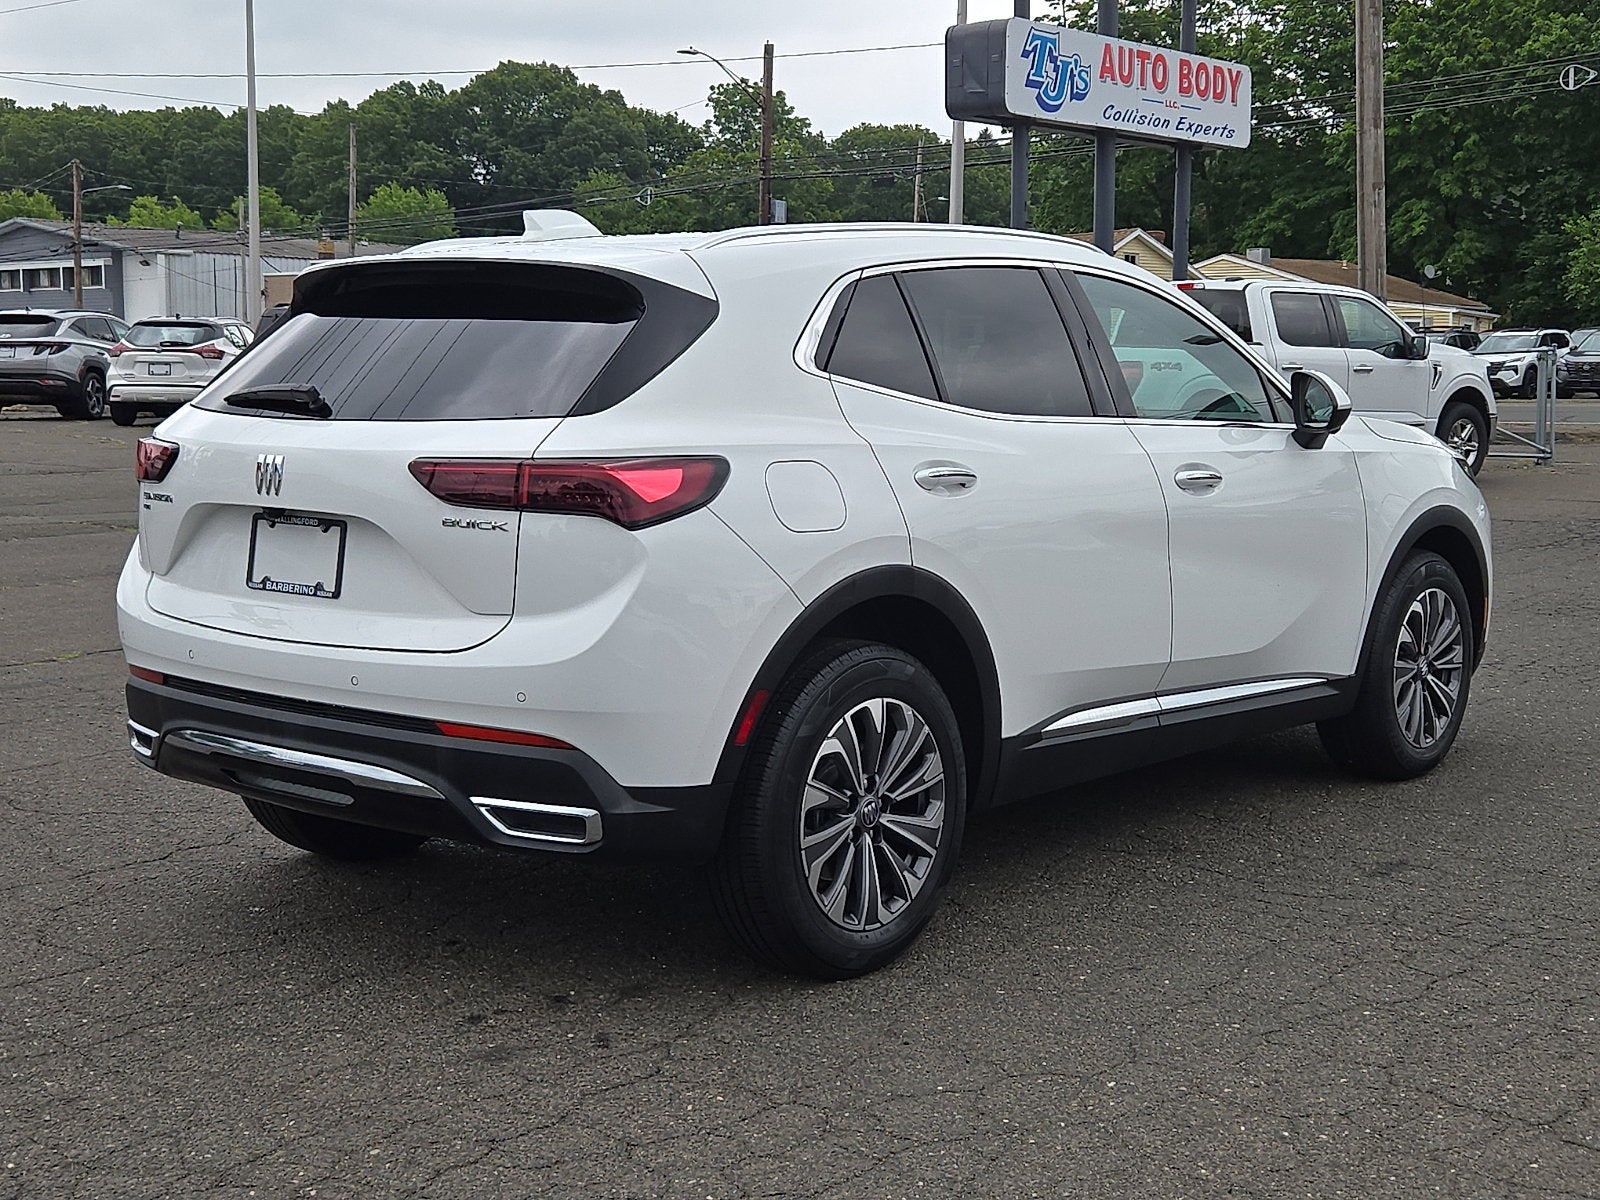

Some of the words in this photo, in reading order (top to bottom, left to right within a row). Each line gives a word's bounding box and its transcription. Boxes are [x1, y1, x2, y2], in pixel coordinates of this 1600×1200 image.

[1021, 26, 1091, 113] TJ's
[1099, 43, 1168, 91] AUTO
[1178, 58, 1242, 106] BODY
[1103, 104, 1170, 129] Collision
[1175, 116, 1236, 140] Experts
[442, 517, 509, 533] BUICK
[265, 581, 315, 595] BARBERINO
